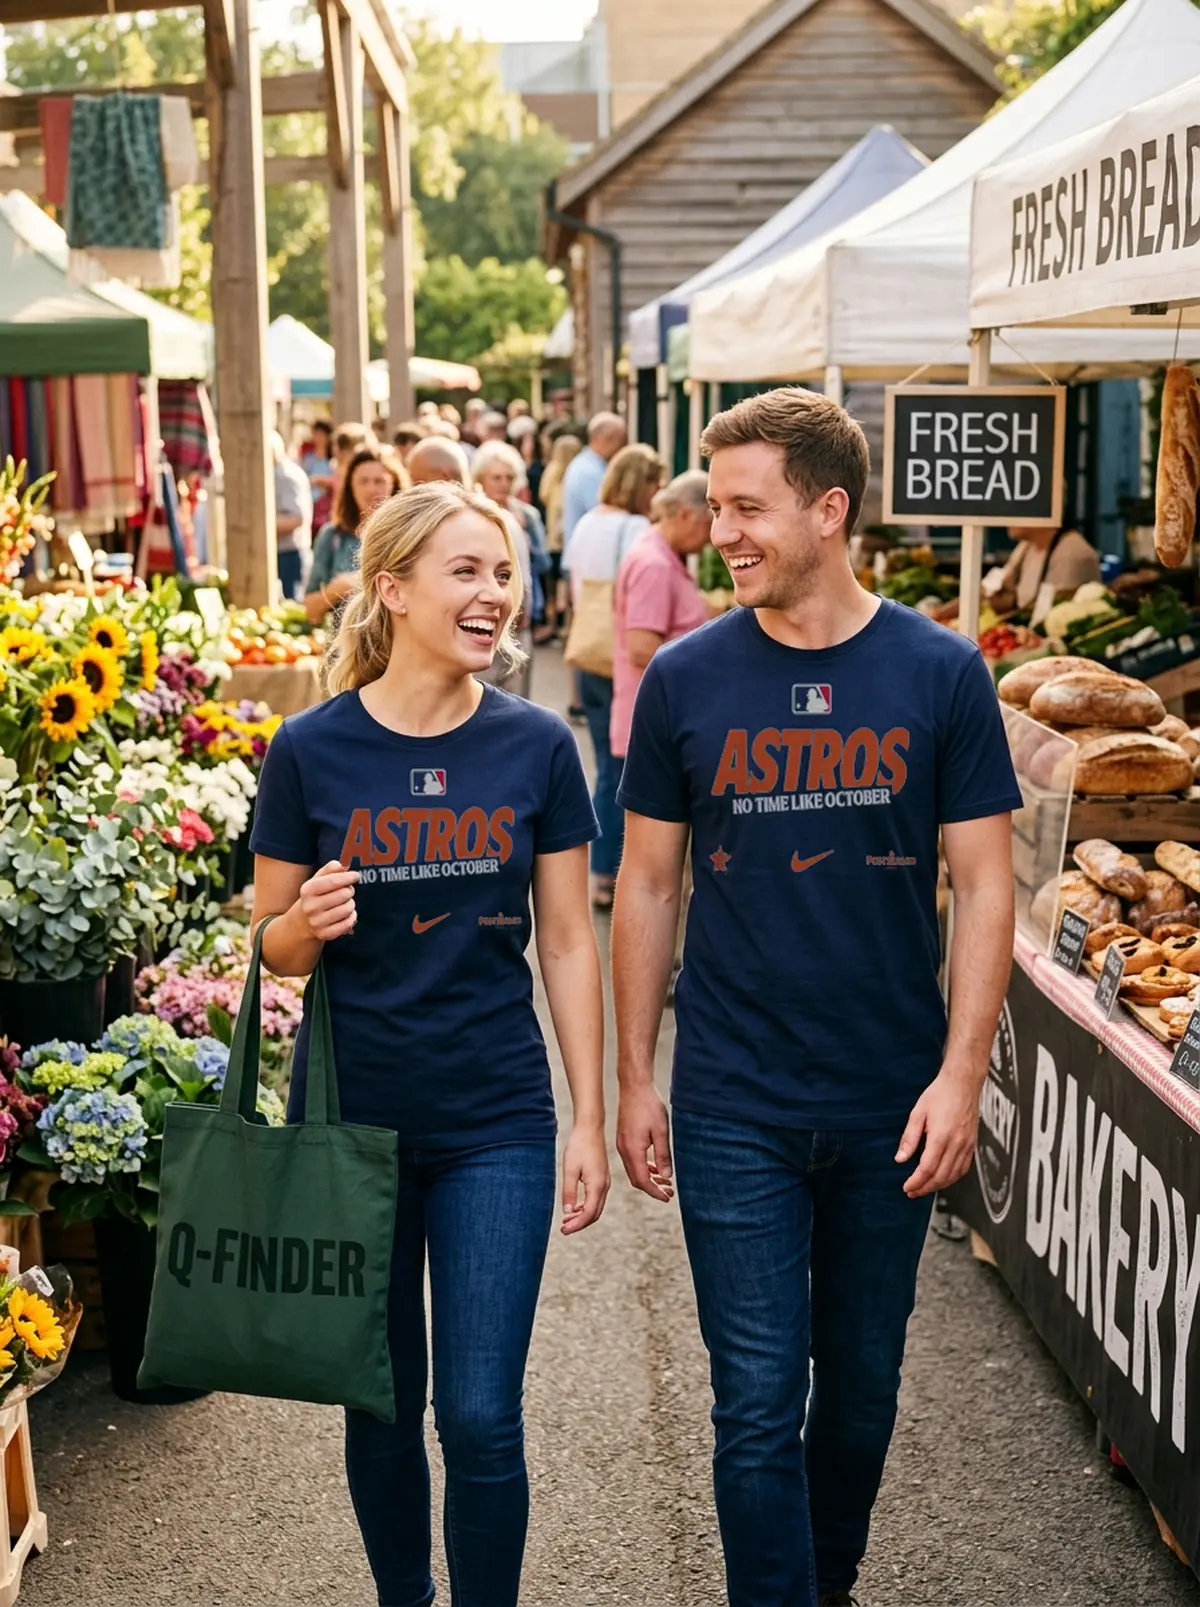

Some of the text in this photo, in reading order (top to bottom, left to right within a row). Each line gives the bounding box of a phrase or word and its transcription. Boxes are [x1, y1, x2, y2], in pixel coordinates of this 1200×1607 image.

[1008, 125, 1200, 288] FRESH BREAD
[910, 412, 1038, 454] FRESH
[907, 458, 1040, 501] BREAD
[711, 727, 910, 796] ASTROS
[732, 788, 891, 815] NO TIME LIKE OCTOBER
[339, 806, 515, 870] ASTROS
[358, 858, 499, 885] NO TIME LIKE OCTOBER
[167, 1221, 366, 1298] Q-FINDER
[1025, 1043, 1200, 1454] BAKERY
